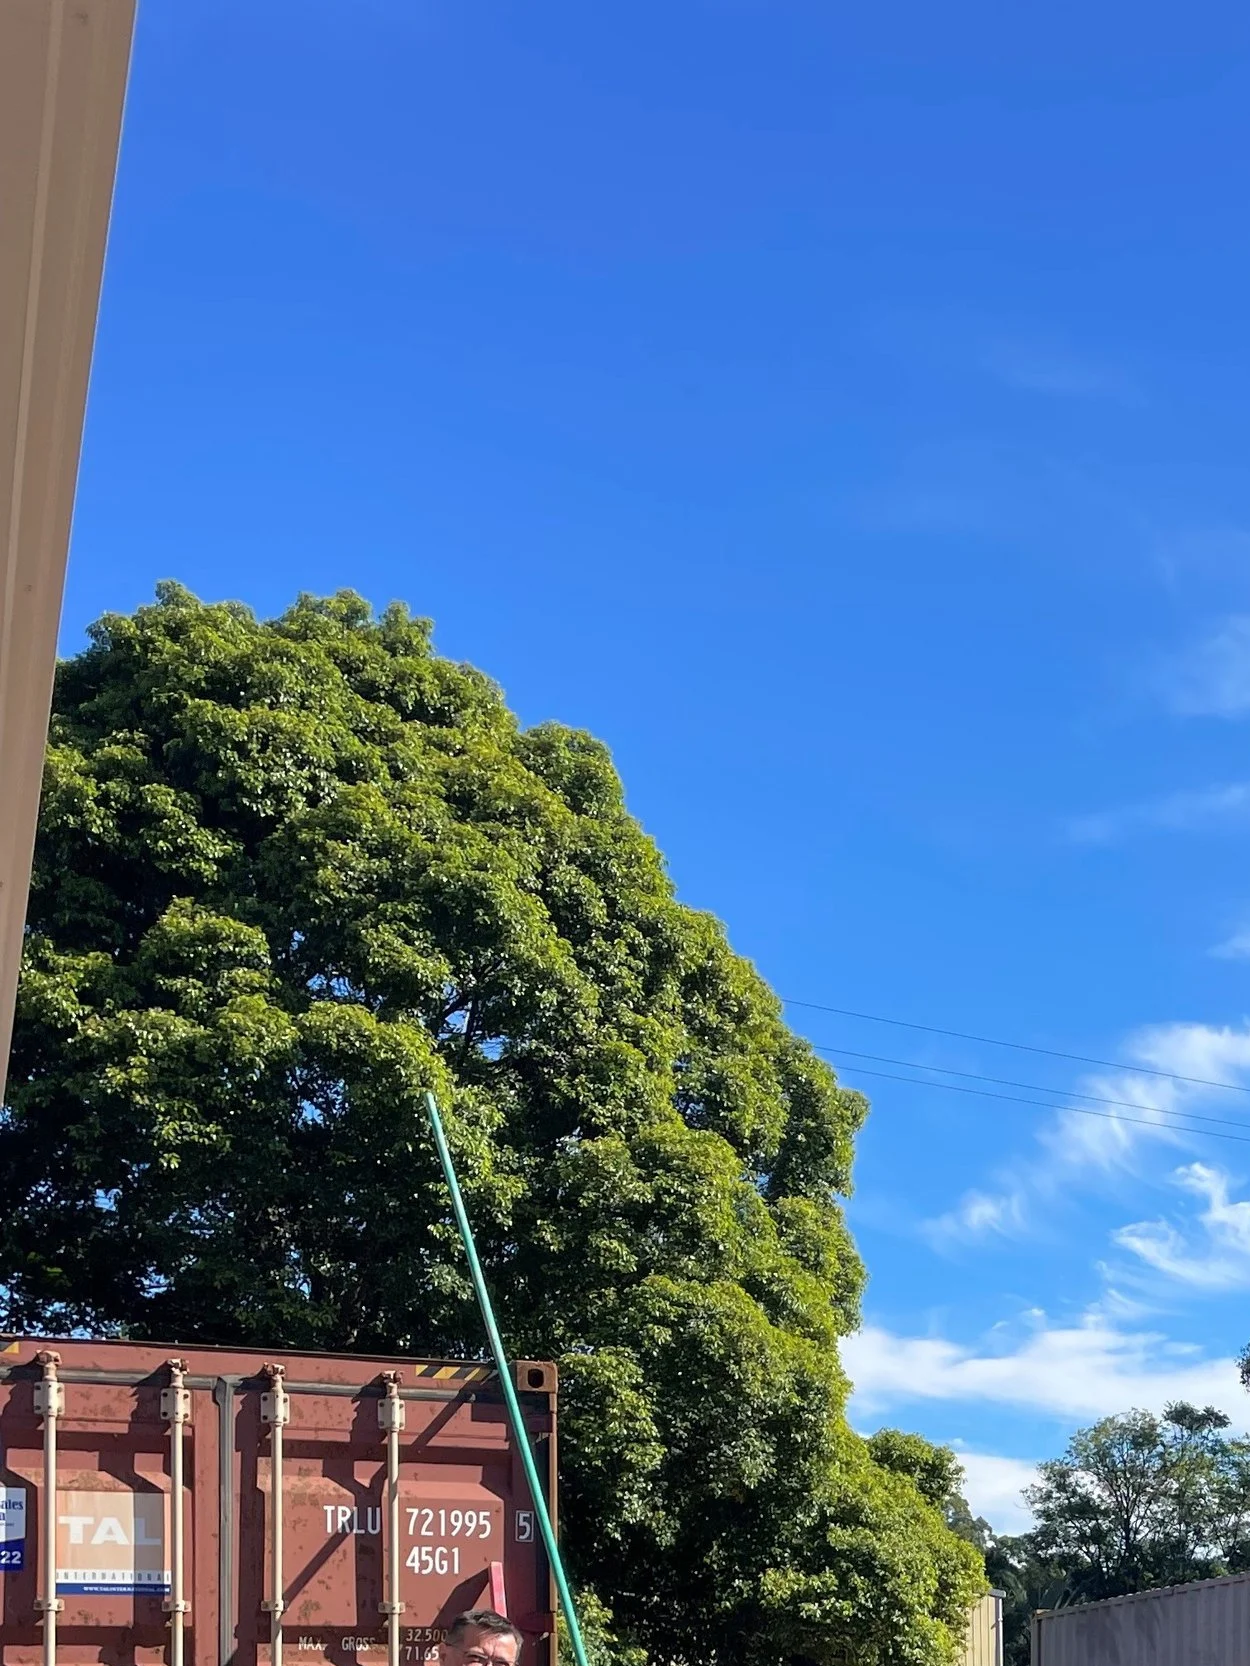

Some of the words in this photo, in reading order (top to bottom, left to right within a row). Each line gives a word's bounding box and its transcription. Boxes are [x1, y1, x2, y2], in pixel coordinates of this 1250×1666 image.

[0, 1499, 24, 1511] ales
[58, 1515, 162, 1546] TAL
[323, 1505, 381, 1535] TRLU
[406, 1508, 492, 1539] 721995
[517, 1512, 532, 1540] 5
[405, 1546, 460, 1575] 45G1
[405, 1646, 439, 1661] 71.65
